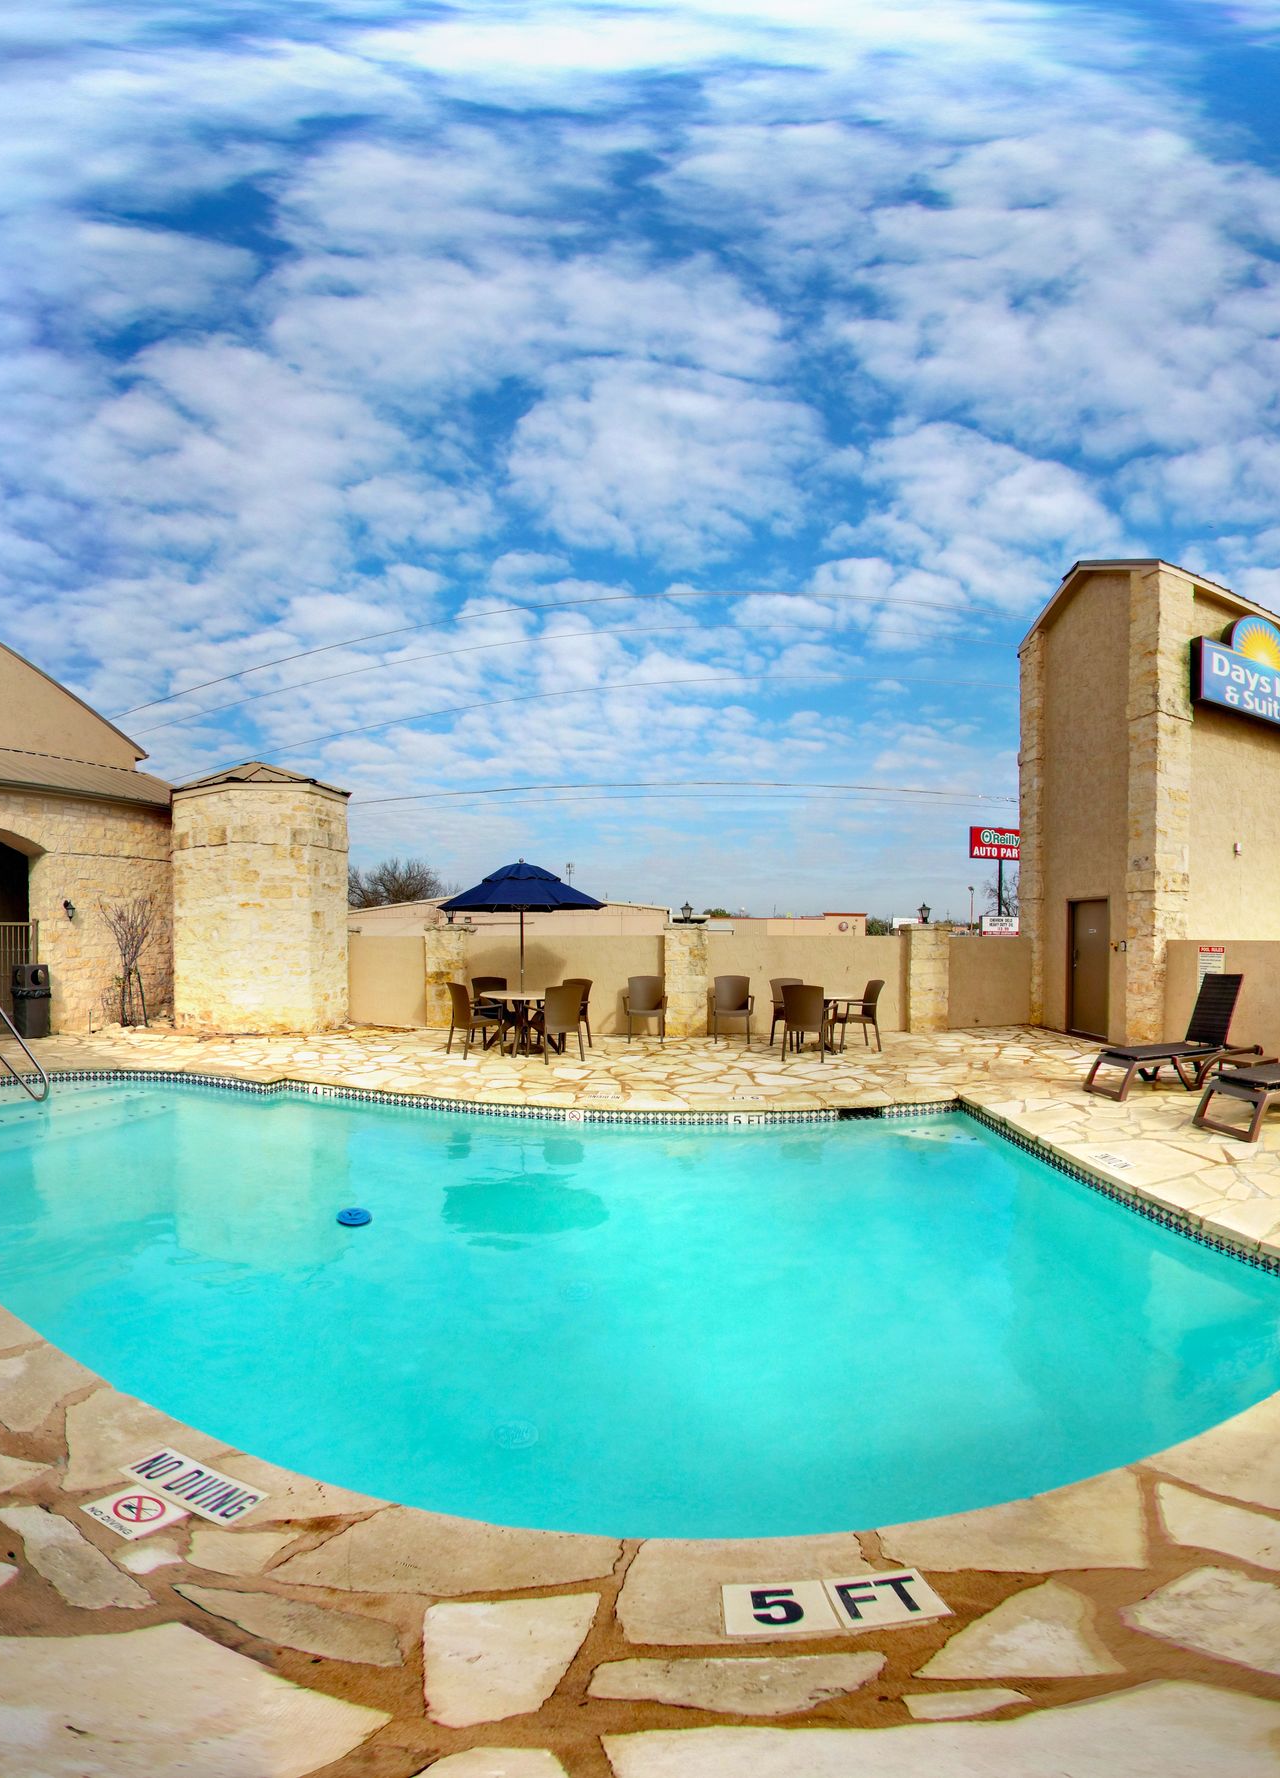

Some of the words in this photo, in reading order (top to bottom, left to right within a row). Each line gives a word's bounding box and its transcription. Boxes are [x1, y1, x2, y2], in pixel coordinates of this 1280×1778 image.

[1212, 652, 1272, 693] Days
[1225, 685, 1239, 705] &
[981, 829, 1020, 847] O'Reilly
[973, 846, 998, 857] AUTO
[1000, 847, 1020, 858] PAR
[312, 1086, 318, 1095] 4
[322, 1087, 333, 1096] FT
[733, 1115, 741, 1124] 5
[748, 1115, 762, 1124] FT
[130, 1452, 184, 1480] NO
[162, 1469, 259, 1519] DIVING
[87, 1506, 105, 1517] NO
[101, 1514, 133, 1536] DIVING
[750, 1589, 804, 1625] 5
[834, 1575, 922, 1620] FT
